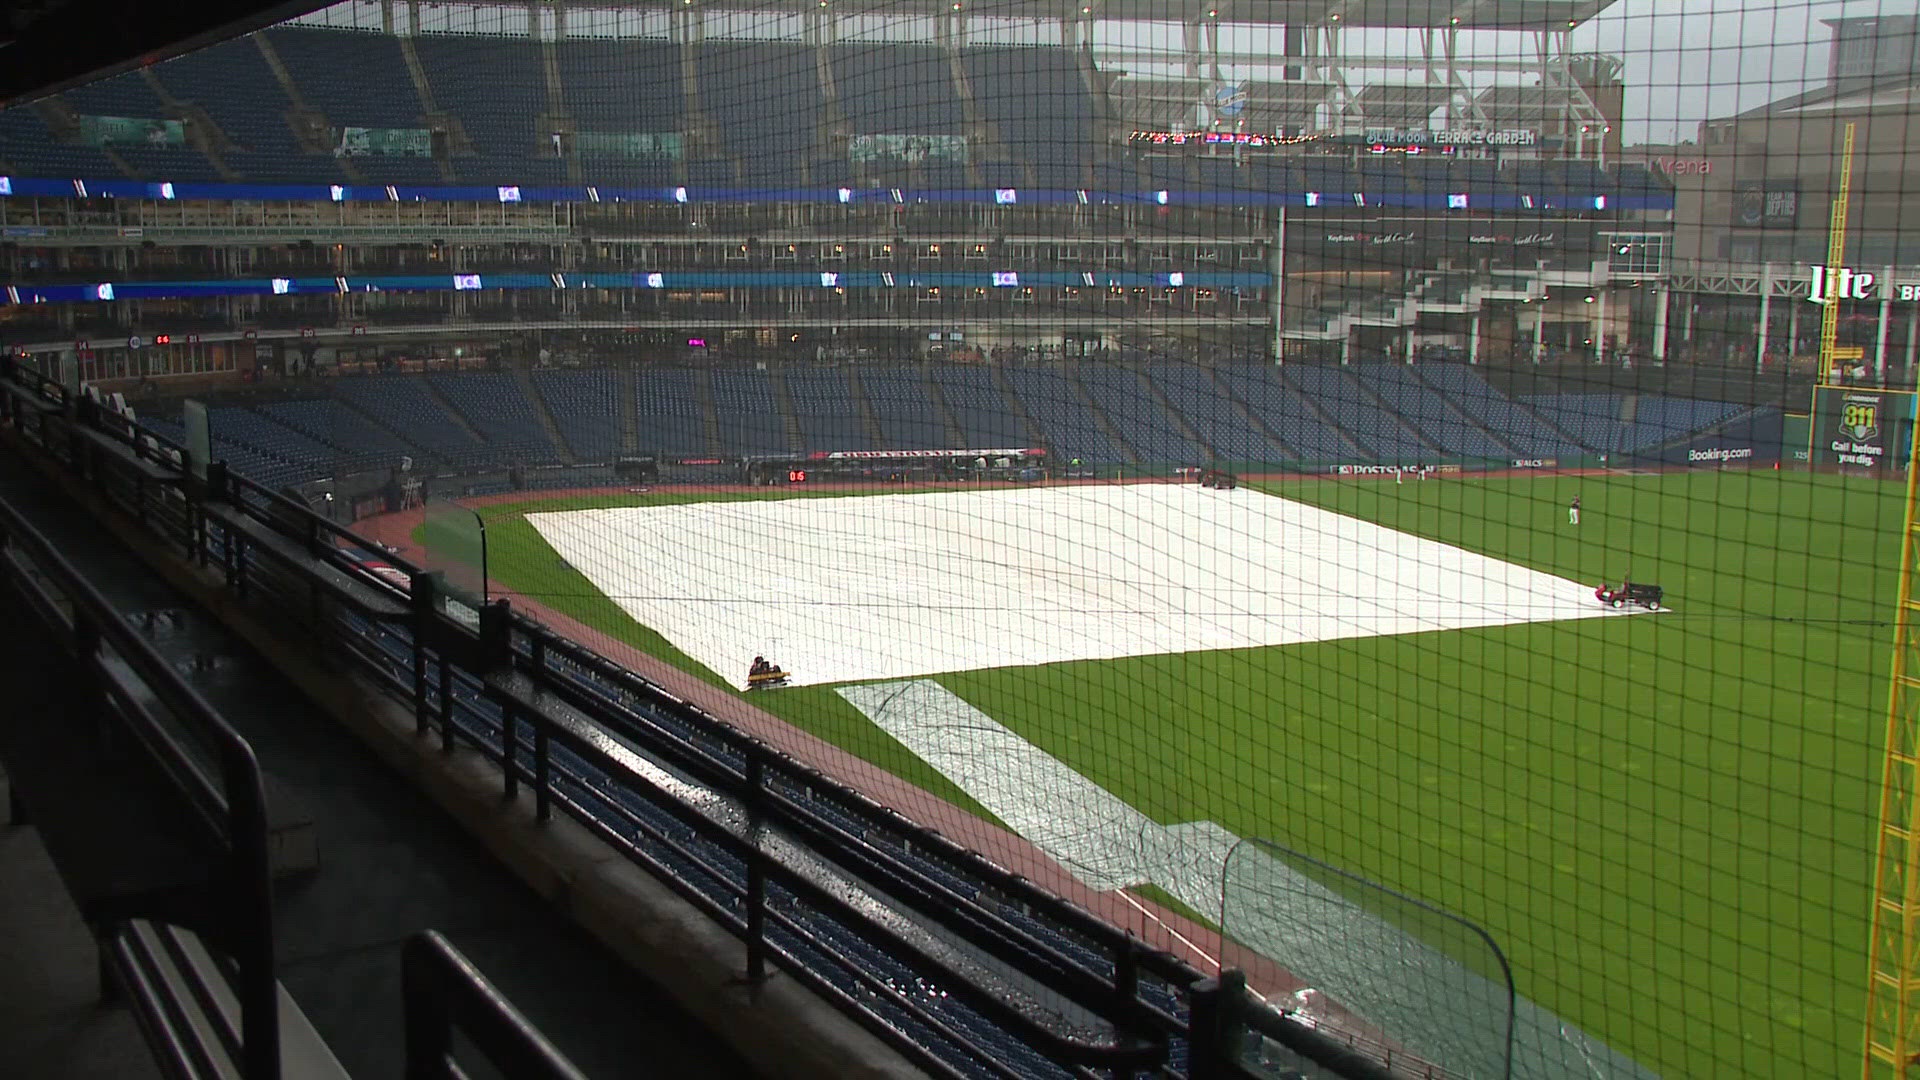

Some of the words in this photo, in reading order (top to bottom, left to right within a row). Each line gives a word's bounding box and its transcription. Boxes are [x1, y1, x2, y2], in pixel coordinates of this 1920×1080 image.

[1367, 130, 1394, 144] BLUE
[1397, 132, 1427, 143] MOON
[1432, 131, 1483, 144] TERRACE
[1487, 131, 1534, 144] GARDEN
[1653, 156, 1711, 174] Arena
[1766, 200, 1795, 215] DEPTHS
[1807, 264, 1875, 304] Lite
[1845, 405, 1875, 428] 811
[1688, 448, 1751, 461] Booking.com
[1832, 441, 1850, 452] Call
[1852, 443, 1883, 455] before
[1838, 453, 1856, 464] you
[1856, 455, 1874, 467] dig.
[1354, 464, 1435, 475] POSTSASN
